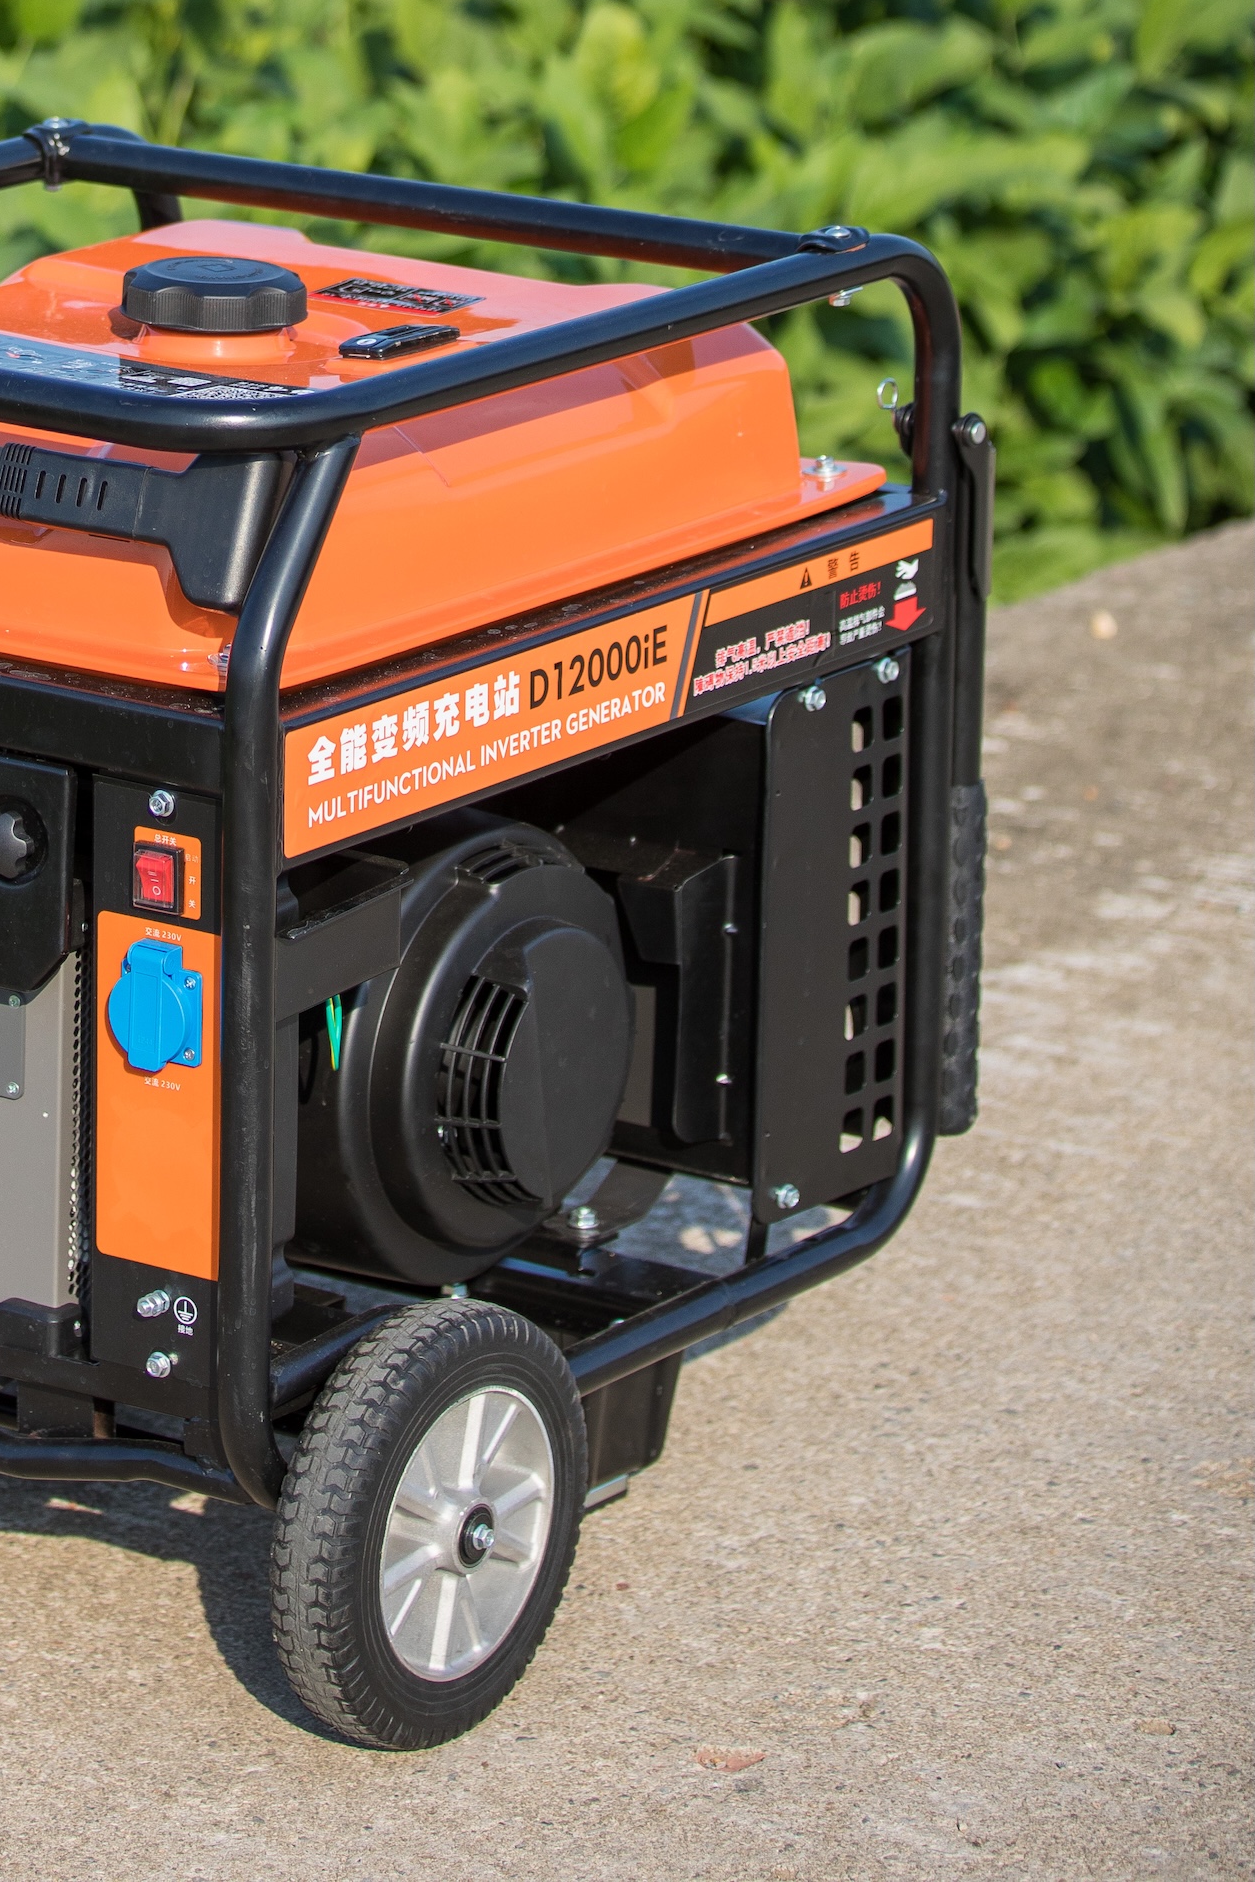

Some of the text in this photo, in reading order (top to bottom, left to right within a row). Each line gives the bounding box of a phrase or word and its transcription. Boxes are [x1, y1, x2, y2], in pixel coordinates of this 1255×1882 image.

[307, 624, 668, 786] 全能变频充电站 D12000iE
[308, 681, 666, 828] MULTIFUNCTIONAL INVERTER GENERATOR
[154, 834, 177, 846] 总开关
[188, 876, 197, 885] 开
[188, 899, 196, 909] 关
[145, 926, 182, 941] 交流 230V
[144, 1076, 181, 1091] 交流 230V
